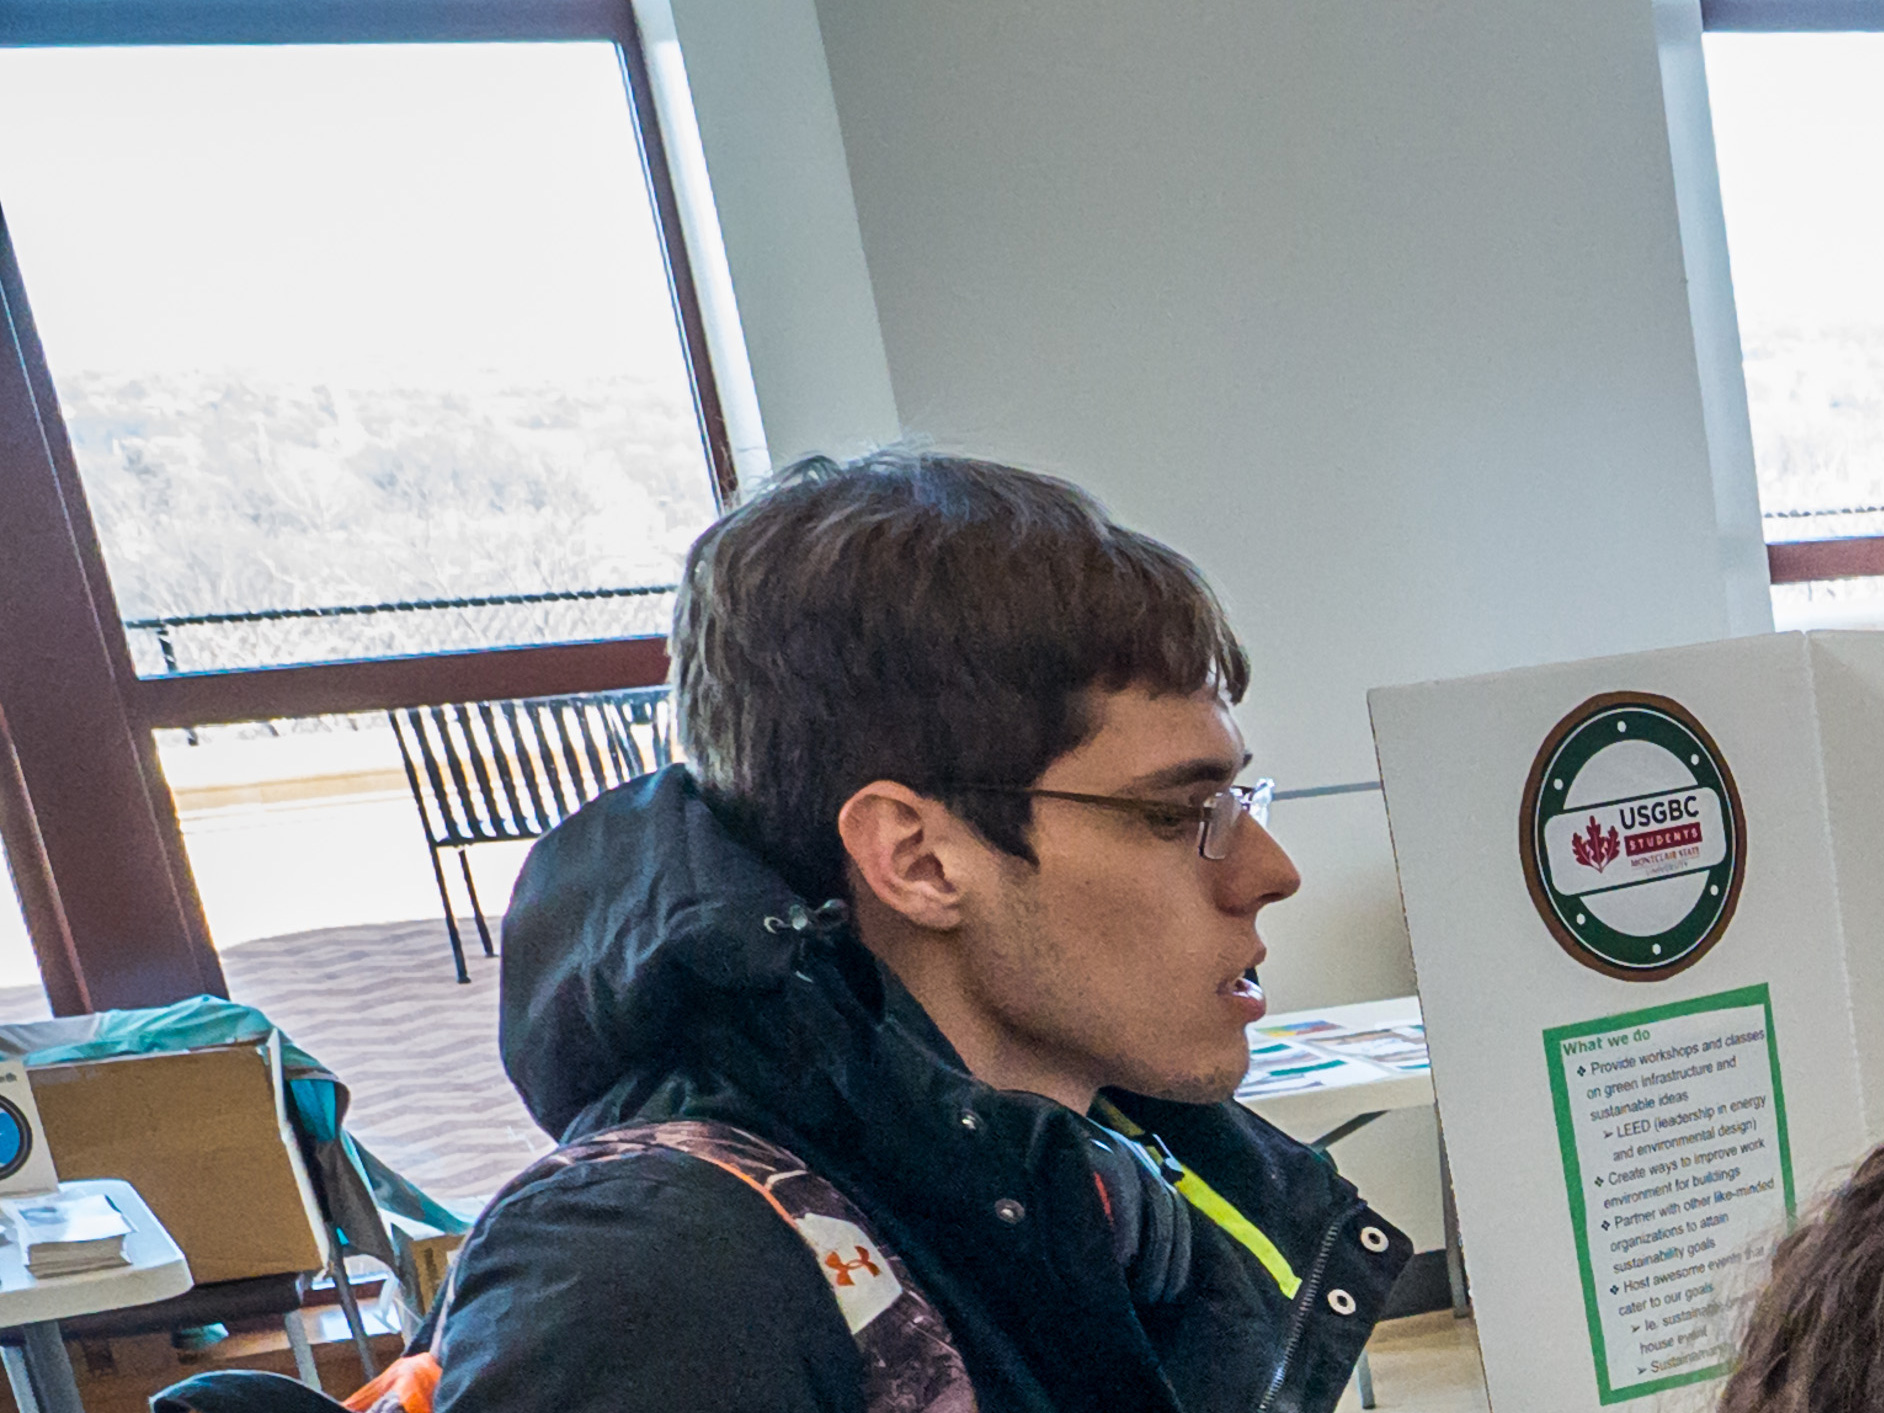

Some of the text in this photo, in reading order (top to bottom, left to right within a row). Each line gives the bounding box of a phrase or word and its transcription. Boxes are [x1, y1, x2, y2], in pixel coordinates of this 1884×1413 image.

[1619, 796, 1699, 830] USGBC
[1629, 827, 1699, 851] STUDENTS
[1562, 1027, 1651, 1055] What we do
[1589, 1029, 1764, 1075] Provide workshops and classes
[1586, 1055, 1737, 1099] on green infrastructure and
[1588, 1089, 1688, 1121] sustainable ideas
[1616, 1094, 1766, 1138] LEED (leadership in energy
[1612, 1116, 1757, 1161] and environmental design)
[1607, 1137, 1764, 1186] Create ways to improve work
[1603, 1165, 1741, 1209] environment for buildings
[1614, 1177, 1775, 1229] Partner with other like-minded
[1609, 1211, 1728, 1255] organizations to attain
[1612, 1237, 1716, 1276] sustainability goals
[1623, 1275, 1649, 1293] Host
[1652, 1262, 1705, 1286] awesome
[1618, 1298, 1647, 1317] cater
[1649, 1294, 1660, 1308] to
[1663, 1289, 1681, 1305] our
[1684, 1280, 1713, 1302] goals
[1639, 1334, 1674, 1355] house
